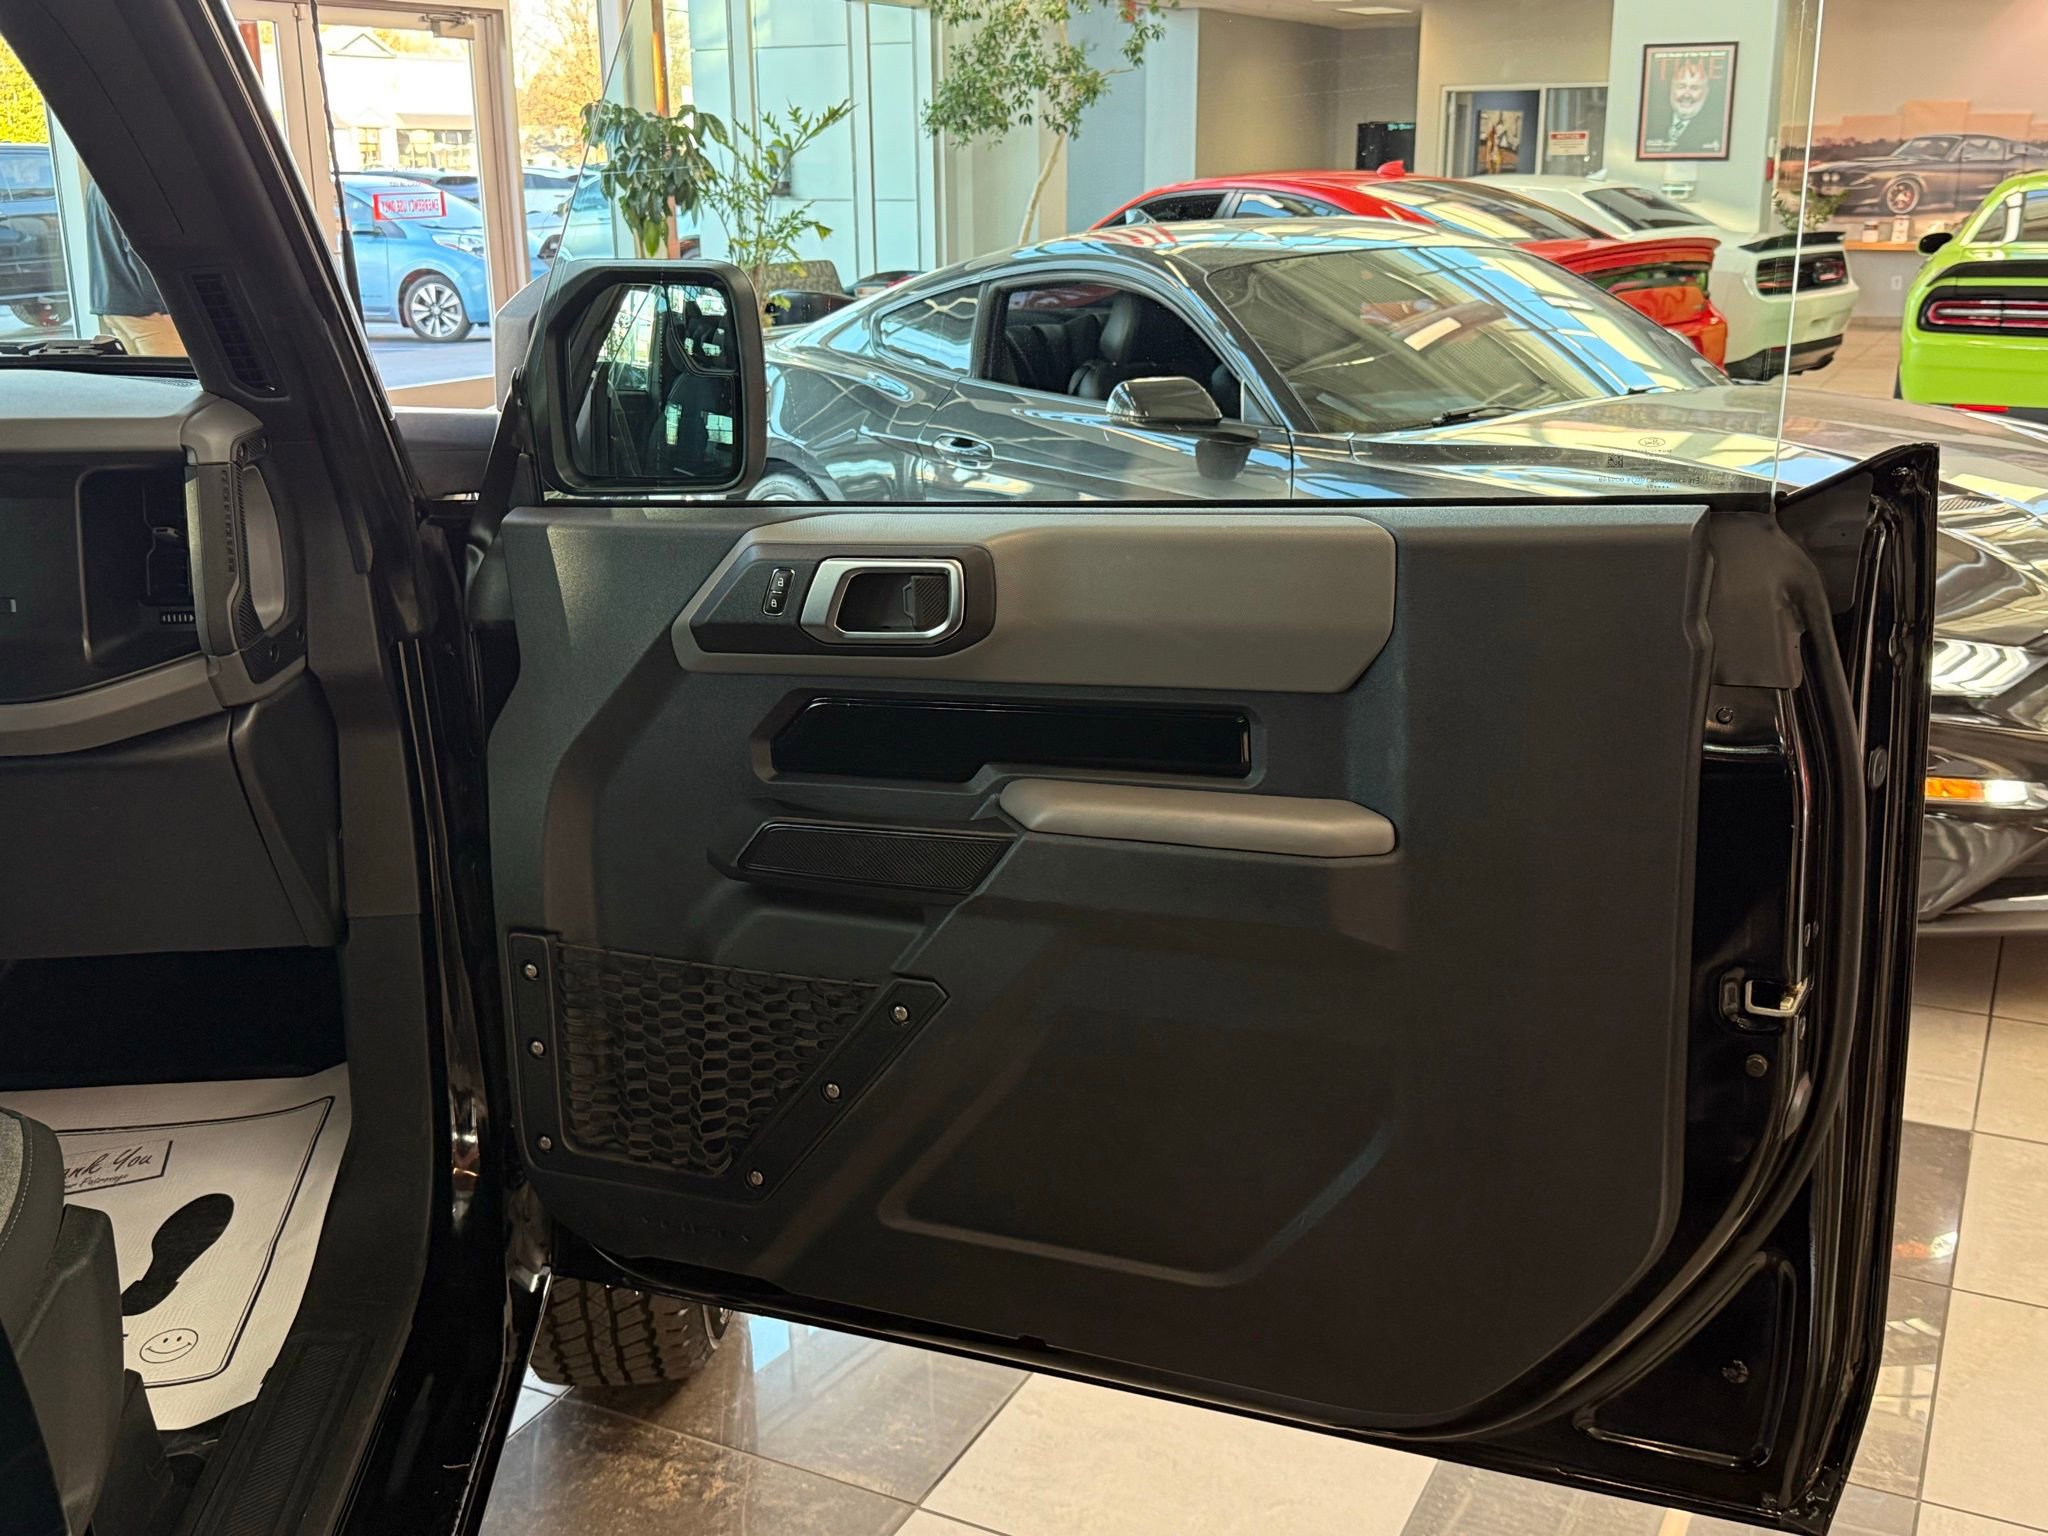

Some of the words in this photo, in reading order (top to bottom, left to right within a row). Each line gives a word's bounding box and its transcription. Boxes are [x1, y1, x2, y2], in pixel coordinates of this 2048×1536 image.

[1656, 58, 1725, 80] TIME
[63, 1153, 109, 1179] ank
[113, 1146, 153, 1172] You
